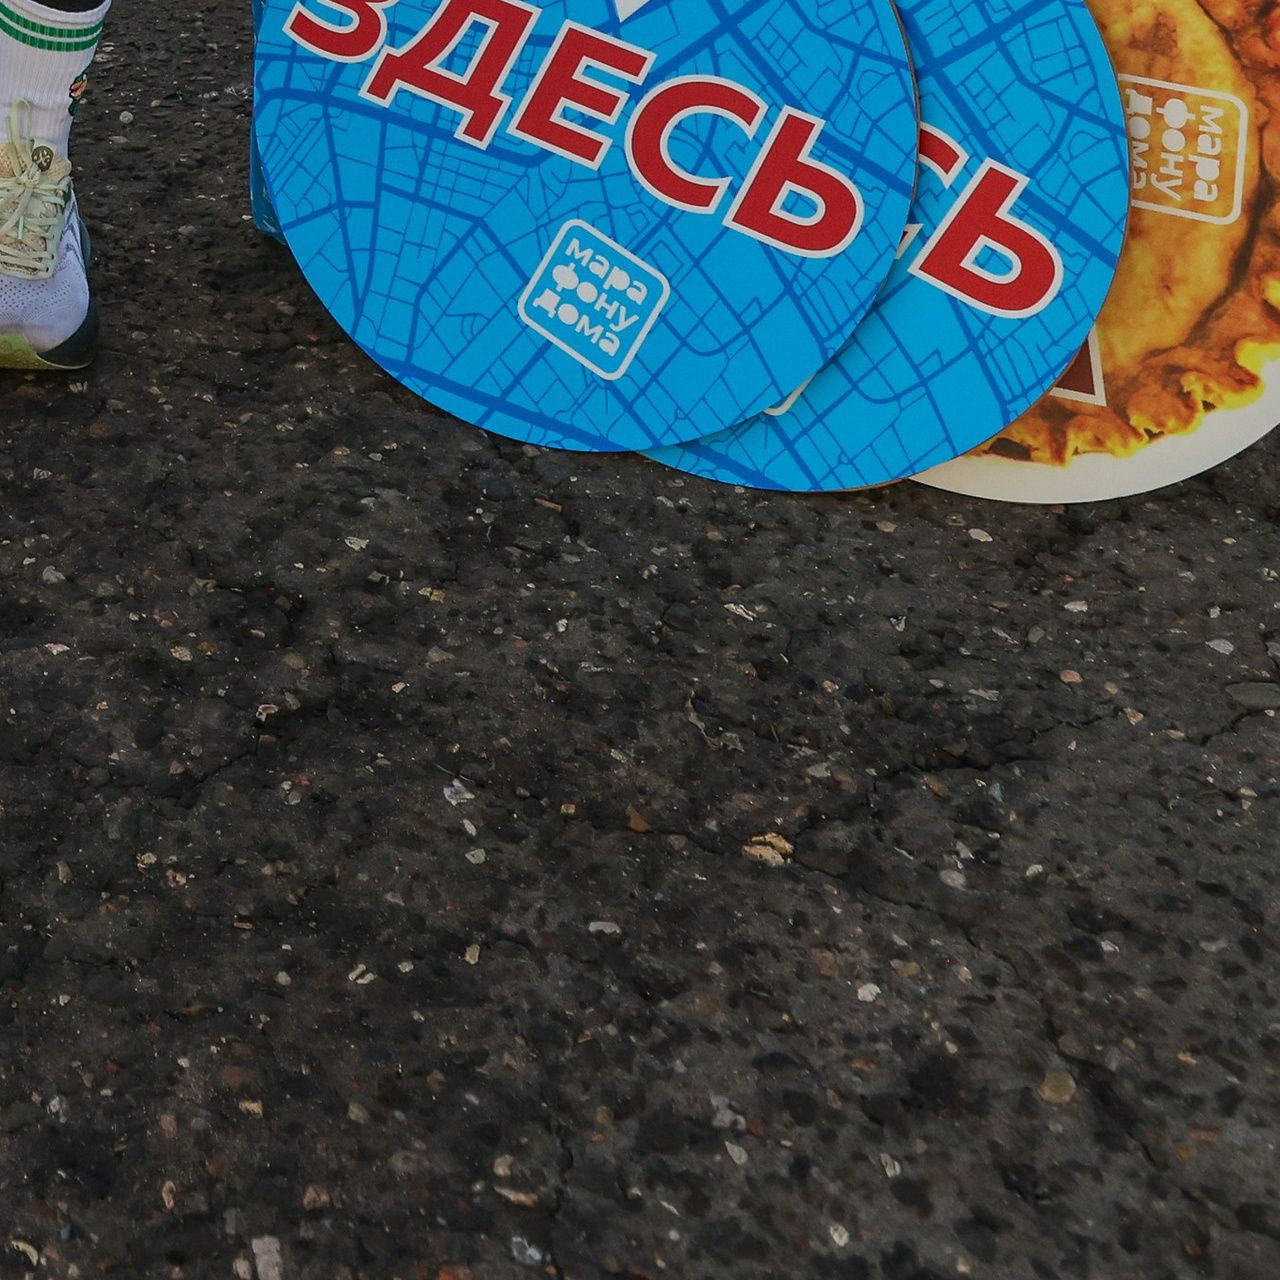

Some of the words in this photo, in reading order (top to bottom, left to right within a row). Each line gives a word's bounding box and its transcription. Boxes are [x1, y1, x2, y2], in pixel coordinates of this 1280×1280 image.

[1150, 98, 1197, 201] фону
[1188, 105, 1225, 202] мара
[552, 262, 640, 332] фону
[565, 237, 648, 306] мара
[532, 288, 621, 357] дома
